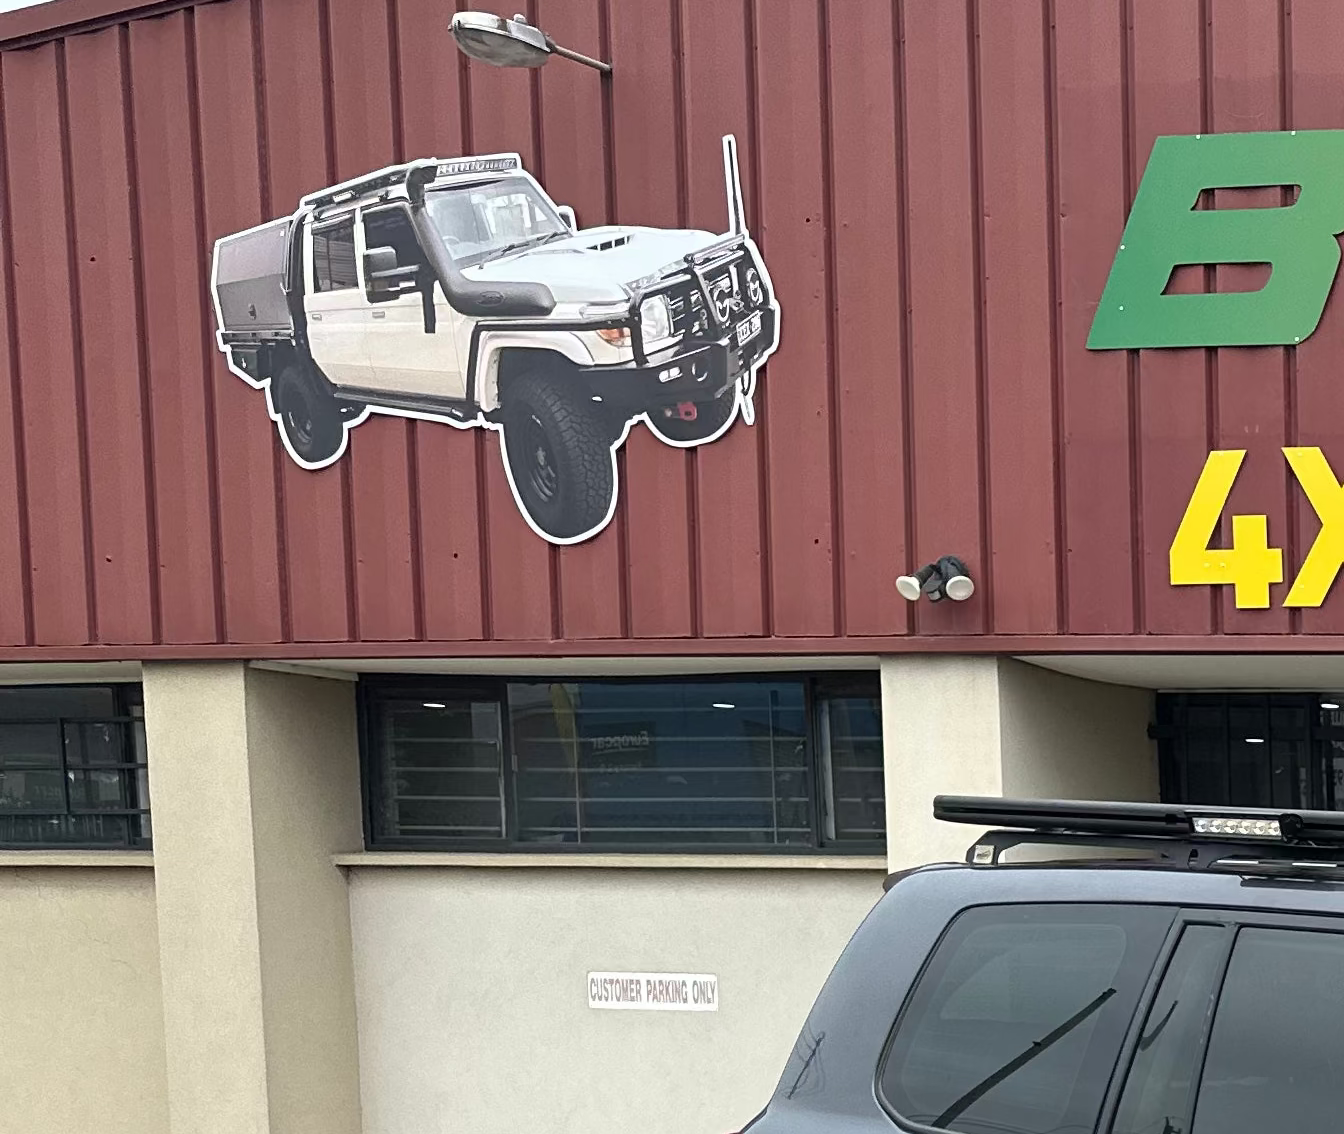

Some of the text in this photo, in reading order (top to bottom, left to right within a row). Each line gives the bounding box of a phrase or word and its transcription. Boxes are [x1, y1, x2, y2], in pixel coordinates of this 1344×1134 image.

[589, 977, 717, 1004] CUSTOMER PARKING ONLY
